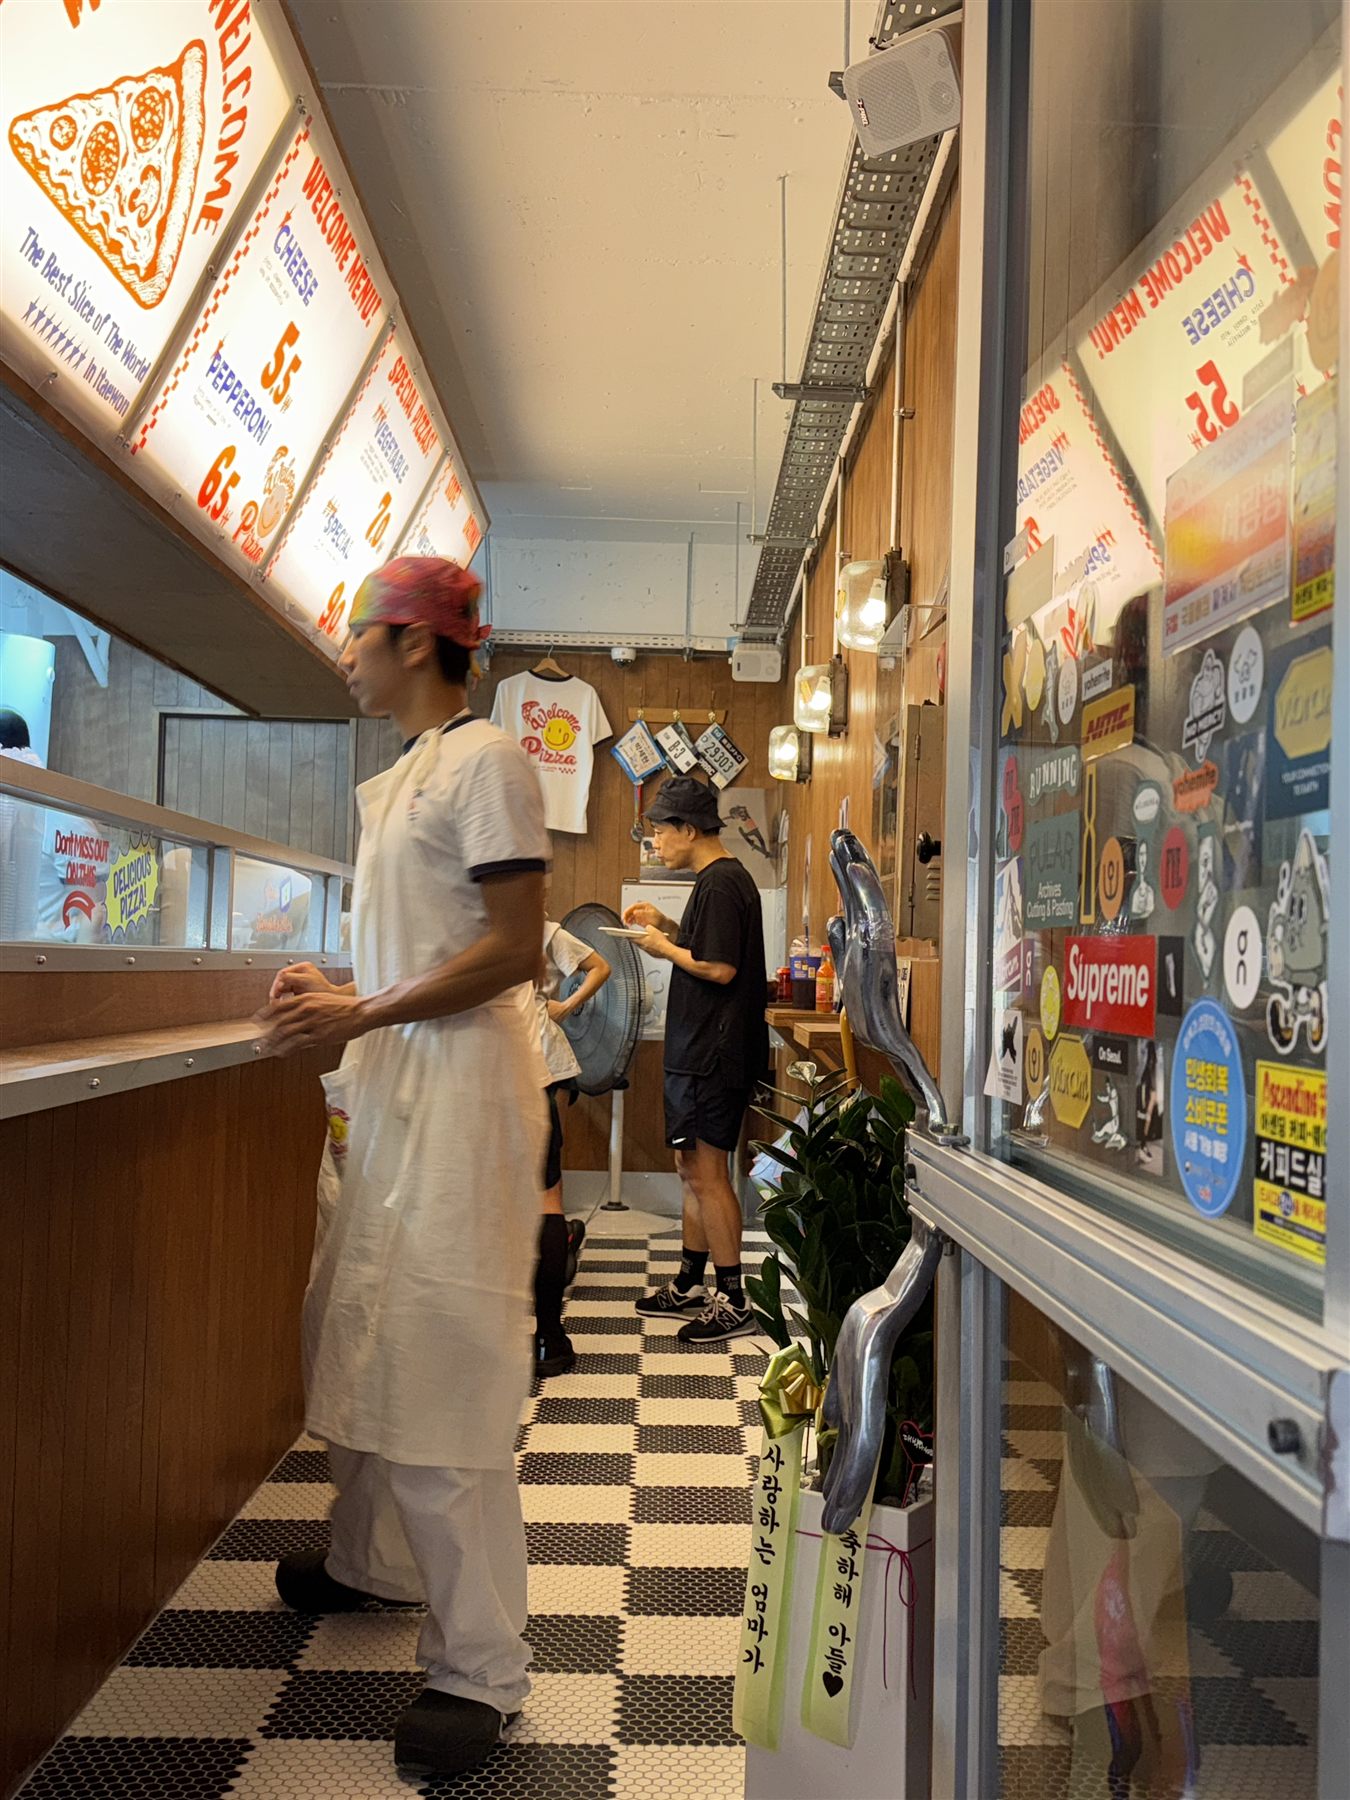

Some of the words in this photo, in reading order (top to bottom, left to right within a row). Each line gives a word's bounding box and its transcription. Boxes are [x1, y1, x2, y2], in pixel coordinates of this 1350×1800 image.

[273, 224, 319, 306] CHEESE
[302, 156, 356, 272] WELCOME
[344, 253, 382, 328] MENU!
[18, 226, 46, 270] The
[48, 252, 73, 296] Best
[68, 271, 95, 323] Slice
[94, 310, 109, 338] of
[105, 313, 124, 357] The
[120, 331, 151, 384] World
[95, 366, 130, 418] Itaewon
[205, 350, 272, 446] PEPPERONI
[387, 355, 418, 418] SPECIAL
[409, 404, 438, 458] PIZZAS!
[373, 421, 409, 484] VEGETABLE
[232, 500, 264, 563] Pizza
[323, 513, 354, 560] SPECIAL
[522, 701, 581, 735] Welcome
[520, 736, 577, 766] Pizza
[704, 741, 735, 773] 29303
[1030, 754, 1077, 799] RUNNING
[65, 860, 78, 885] ON
[78, 863, 97, 888] THIS
[74, 834, 93, 860] MISS
[93, 838, 109, 862] OUT
[113, 852, 151, 898] DELICIOUS
[1037, 880, 1062, 898] Archives
[120, 884, 147, 923] PIZZA!
[1027, 901, 1045, 919] Cutting
[1051, 898, 1074, 921] Pasting
[1067, 943, 1149, 1019] Supreme
[1184, 1095, 1229, 1136] 소비쿠폰
[1260, 1141, 1327, 1197] 커피드실
[754, 1443, 785, 1566] 사랑하는
[833, 1528, 862, 1610] 축하해
[742, 1582, 769, 1675] 엄마가
[824, 1622, 851, 1675] 아들
